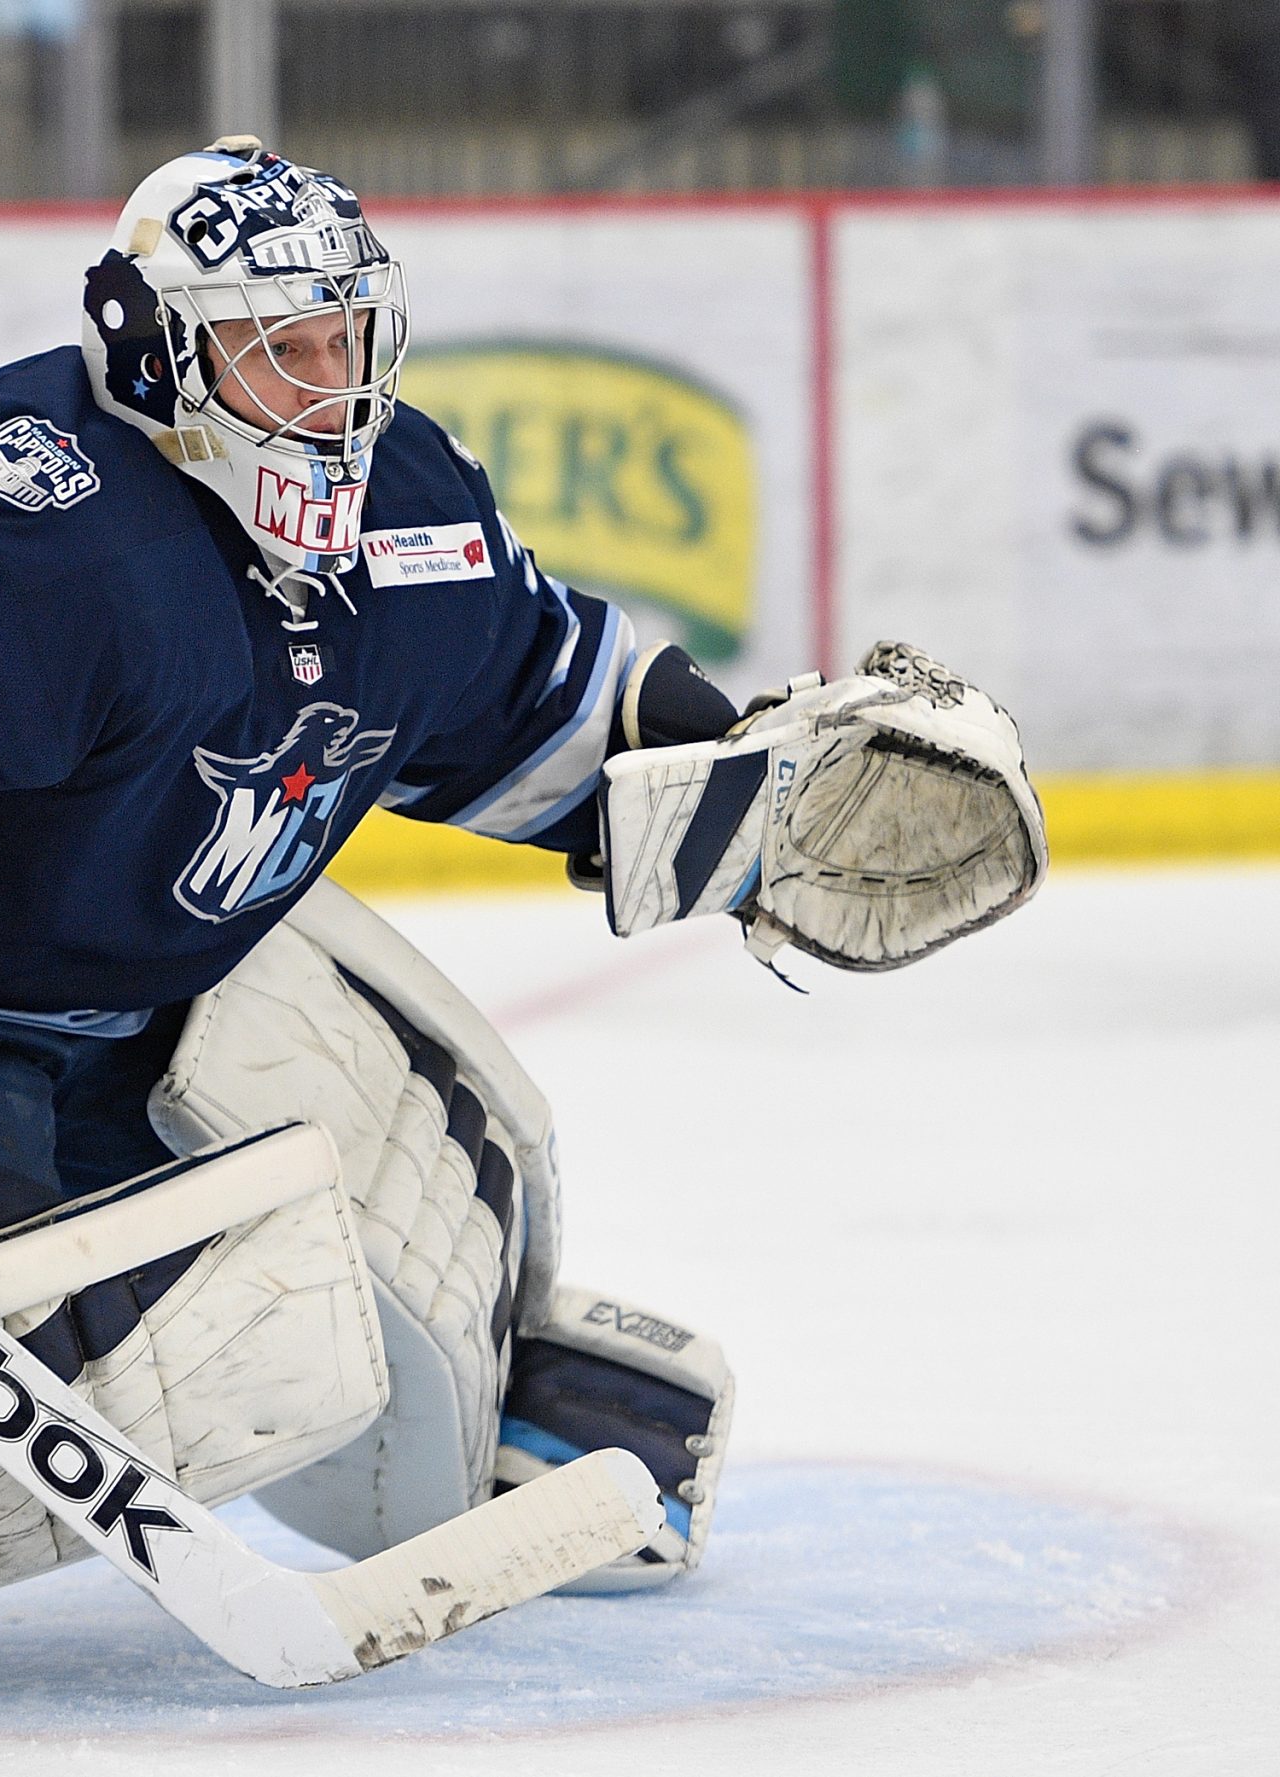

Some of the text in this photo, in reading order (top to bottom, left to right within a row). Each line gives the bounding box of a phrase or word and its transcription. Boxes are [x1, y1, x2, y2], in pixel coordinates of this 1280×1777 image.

[30, 426, 82, 470] MADISON
[367, 533, 433, 557] UW Health
[399, 557, 461, 577] Sports Medicine
[293, 656, 320, 667] USHL
